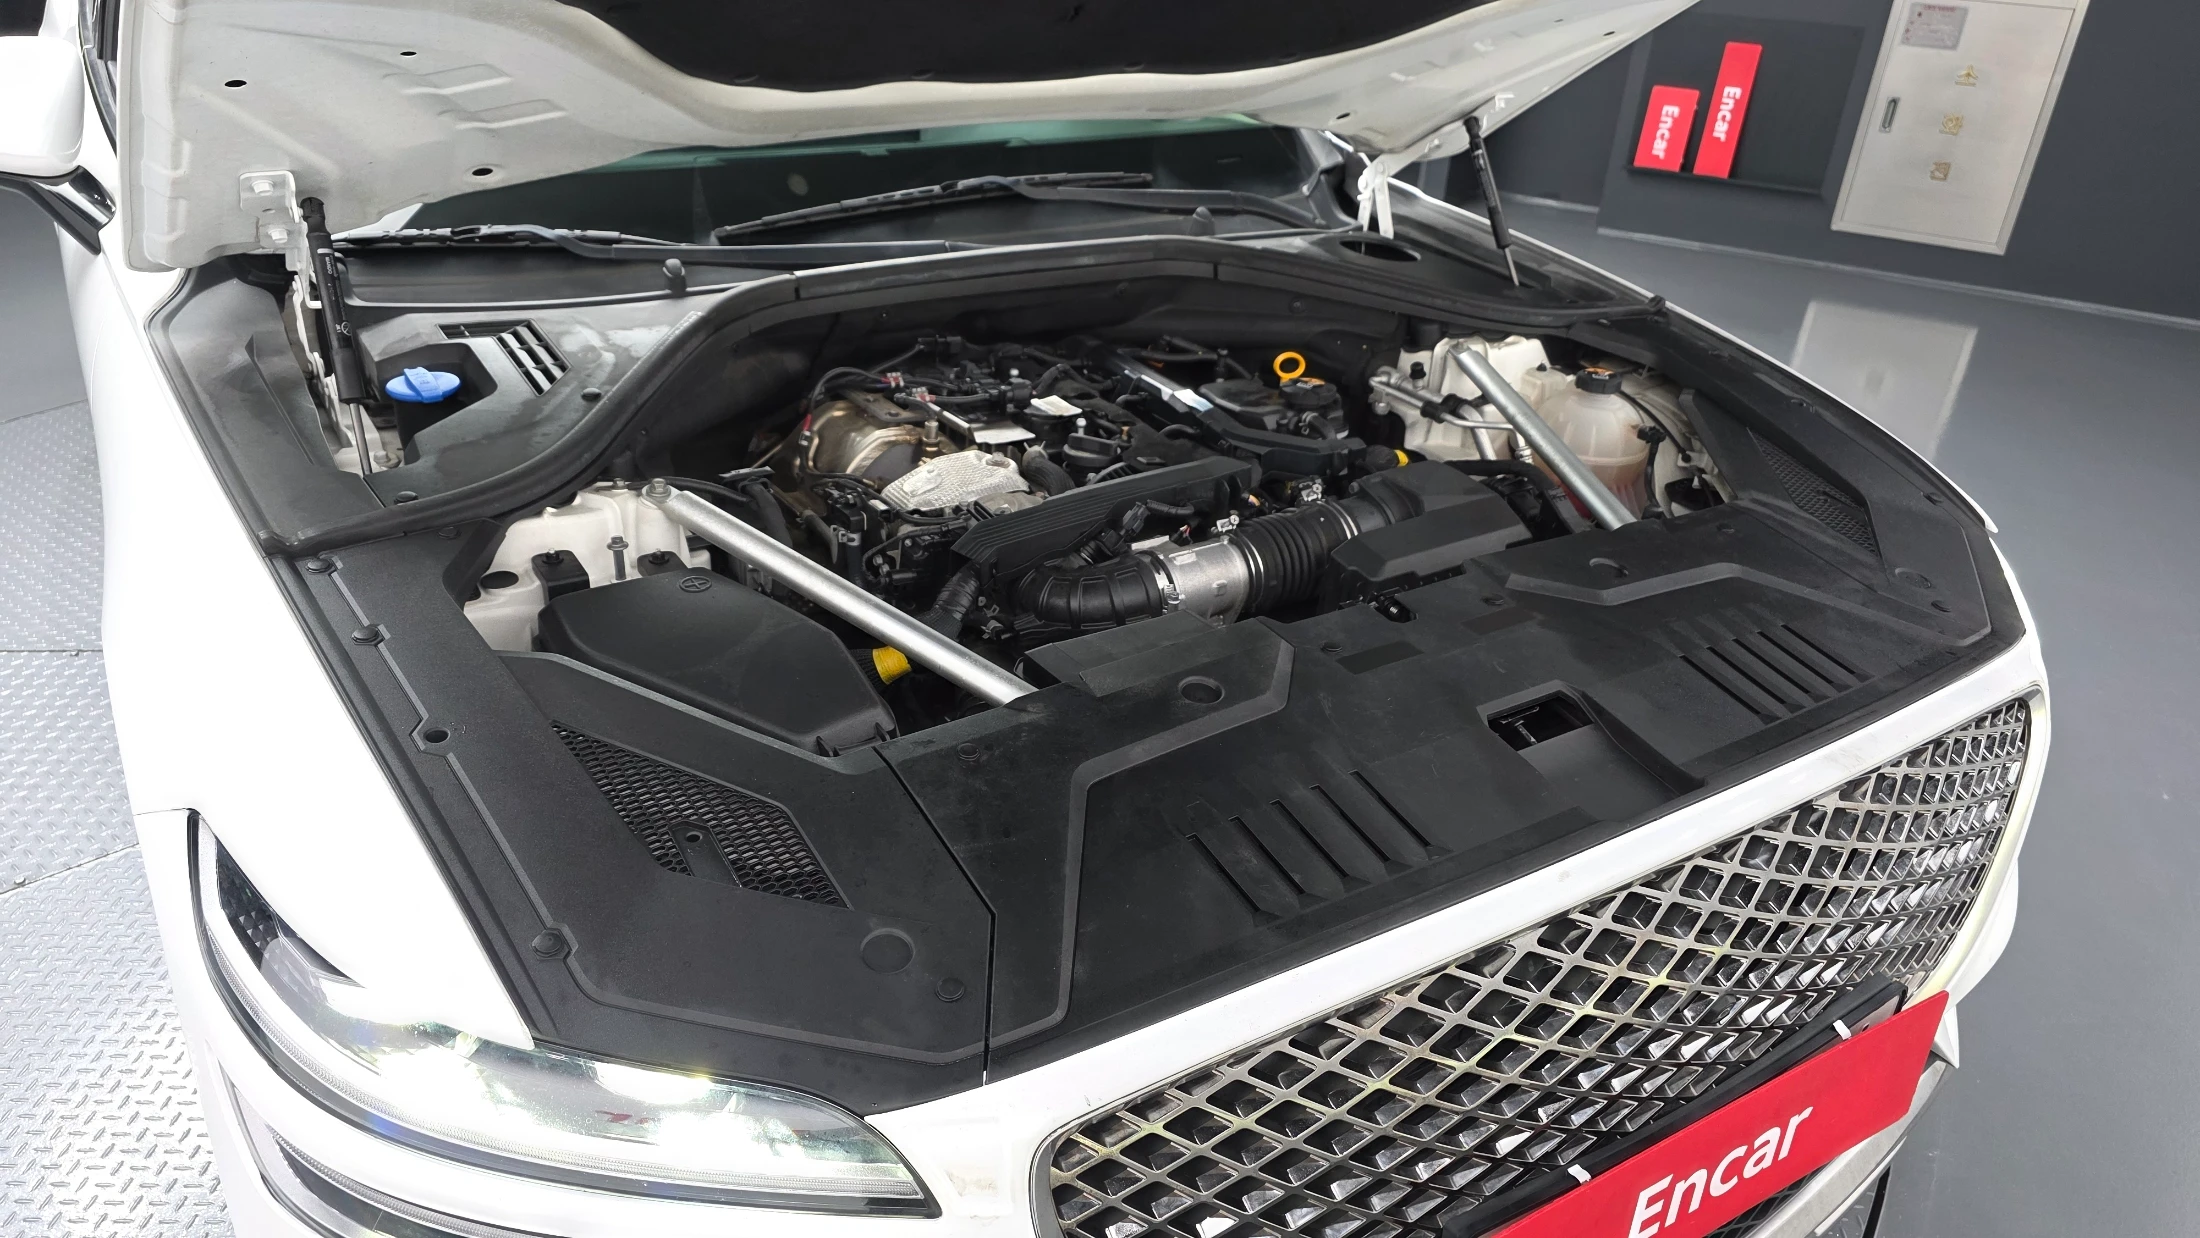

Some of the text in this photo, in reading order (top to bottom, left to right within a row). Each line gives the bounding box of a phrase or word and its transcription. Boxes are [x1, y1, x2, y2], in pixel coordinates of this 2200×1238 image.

[1651, 104, 1680, 160] Encar
[1712, 86, 1742, 142] Encar
[1627, 1106, 1814, 1238] Encar
